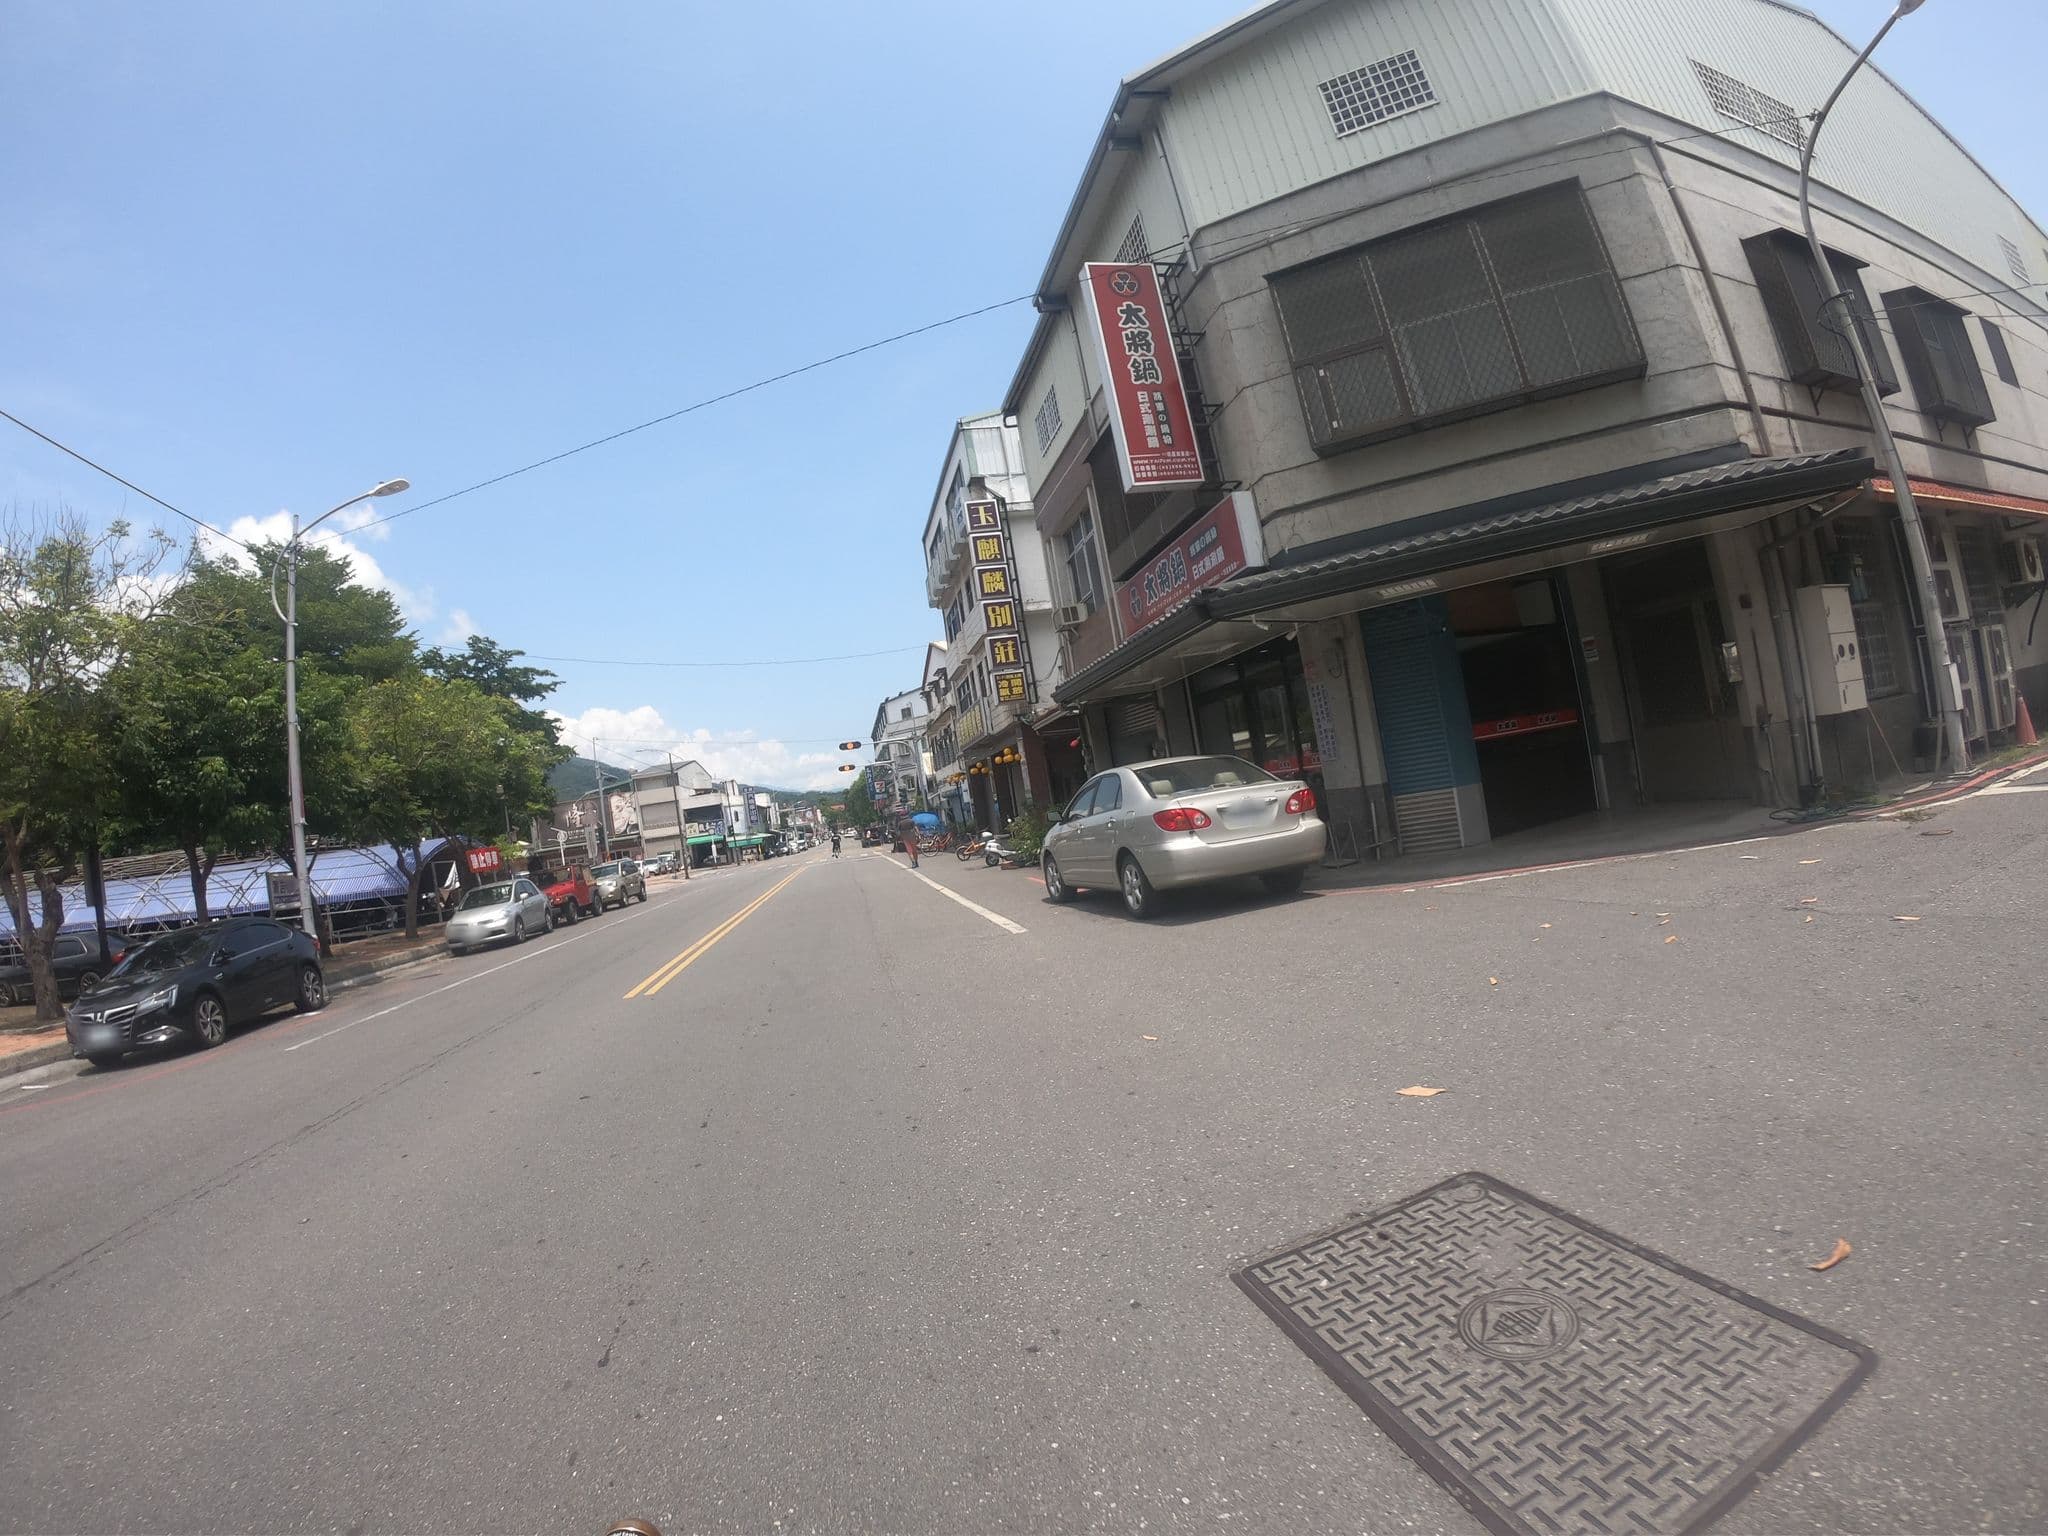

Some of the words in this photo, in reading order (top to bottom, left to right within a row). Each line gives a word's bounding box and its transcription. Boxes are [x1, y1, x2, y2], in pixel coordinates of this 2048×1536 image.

[1118, 302, 1162, 385] 太將鍋
[972, 506, 1017, 663] 玉麒麟別莊
[1144, 546, 1188, 606] 太將鍋
[470, 851, 499, 869] 禁止停車
